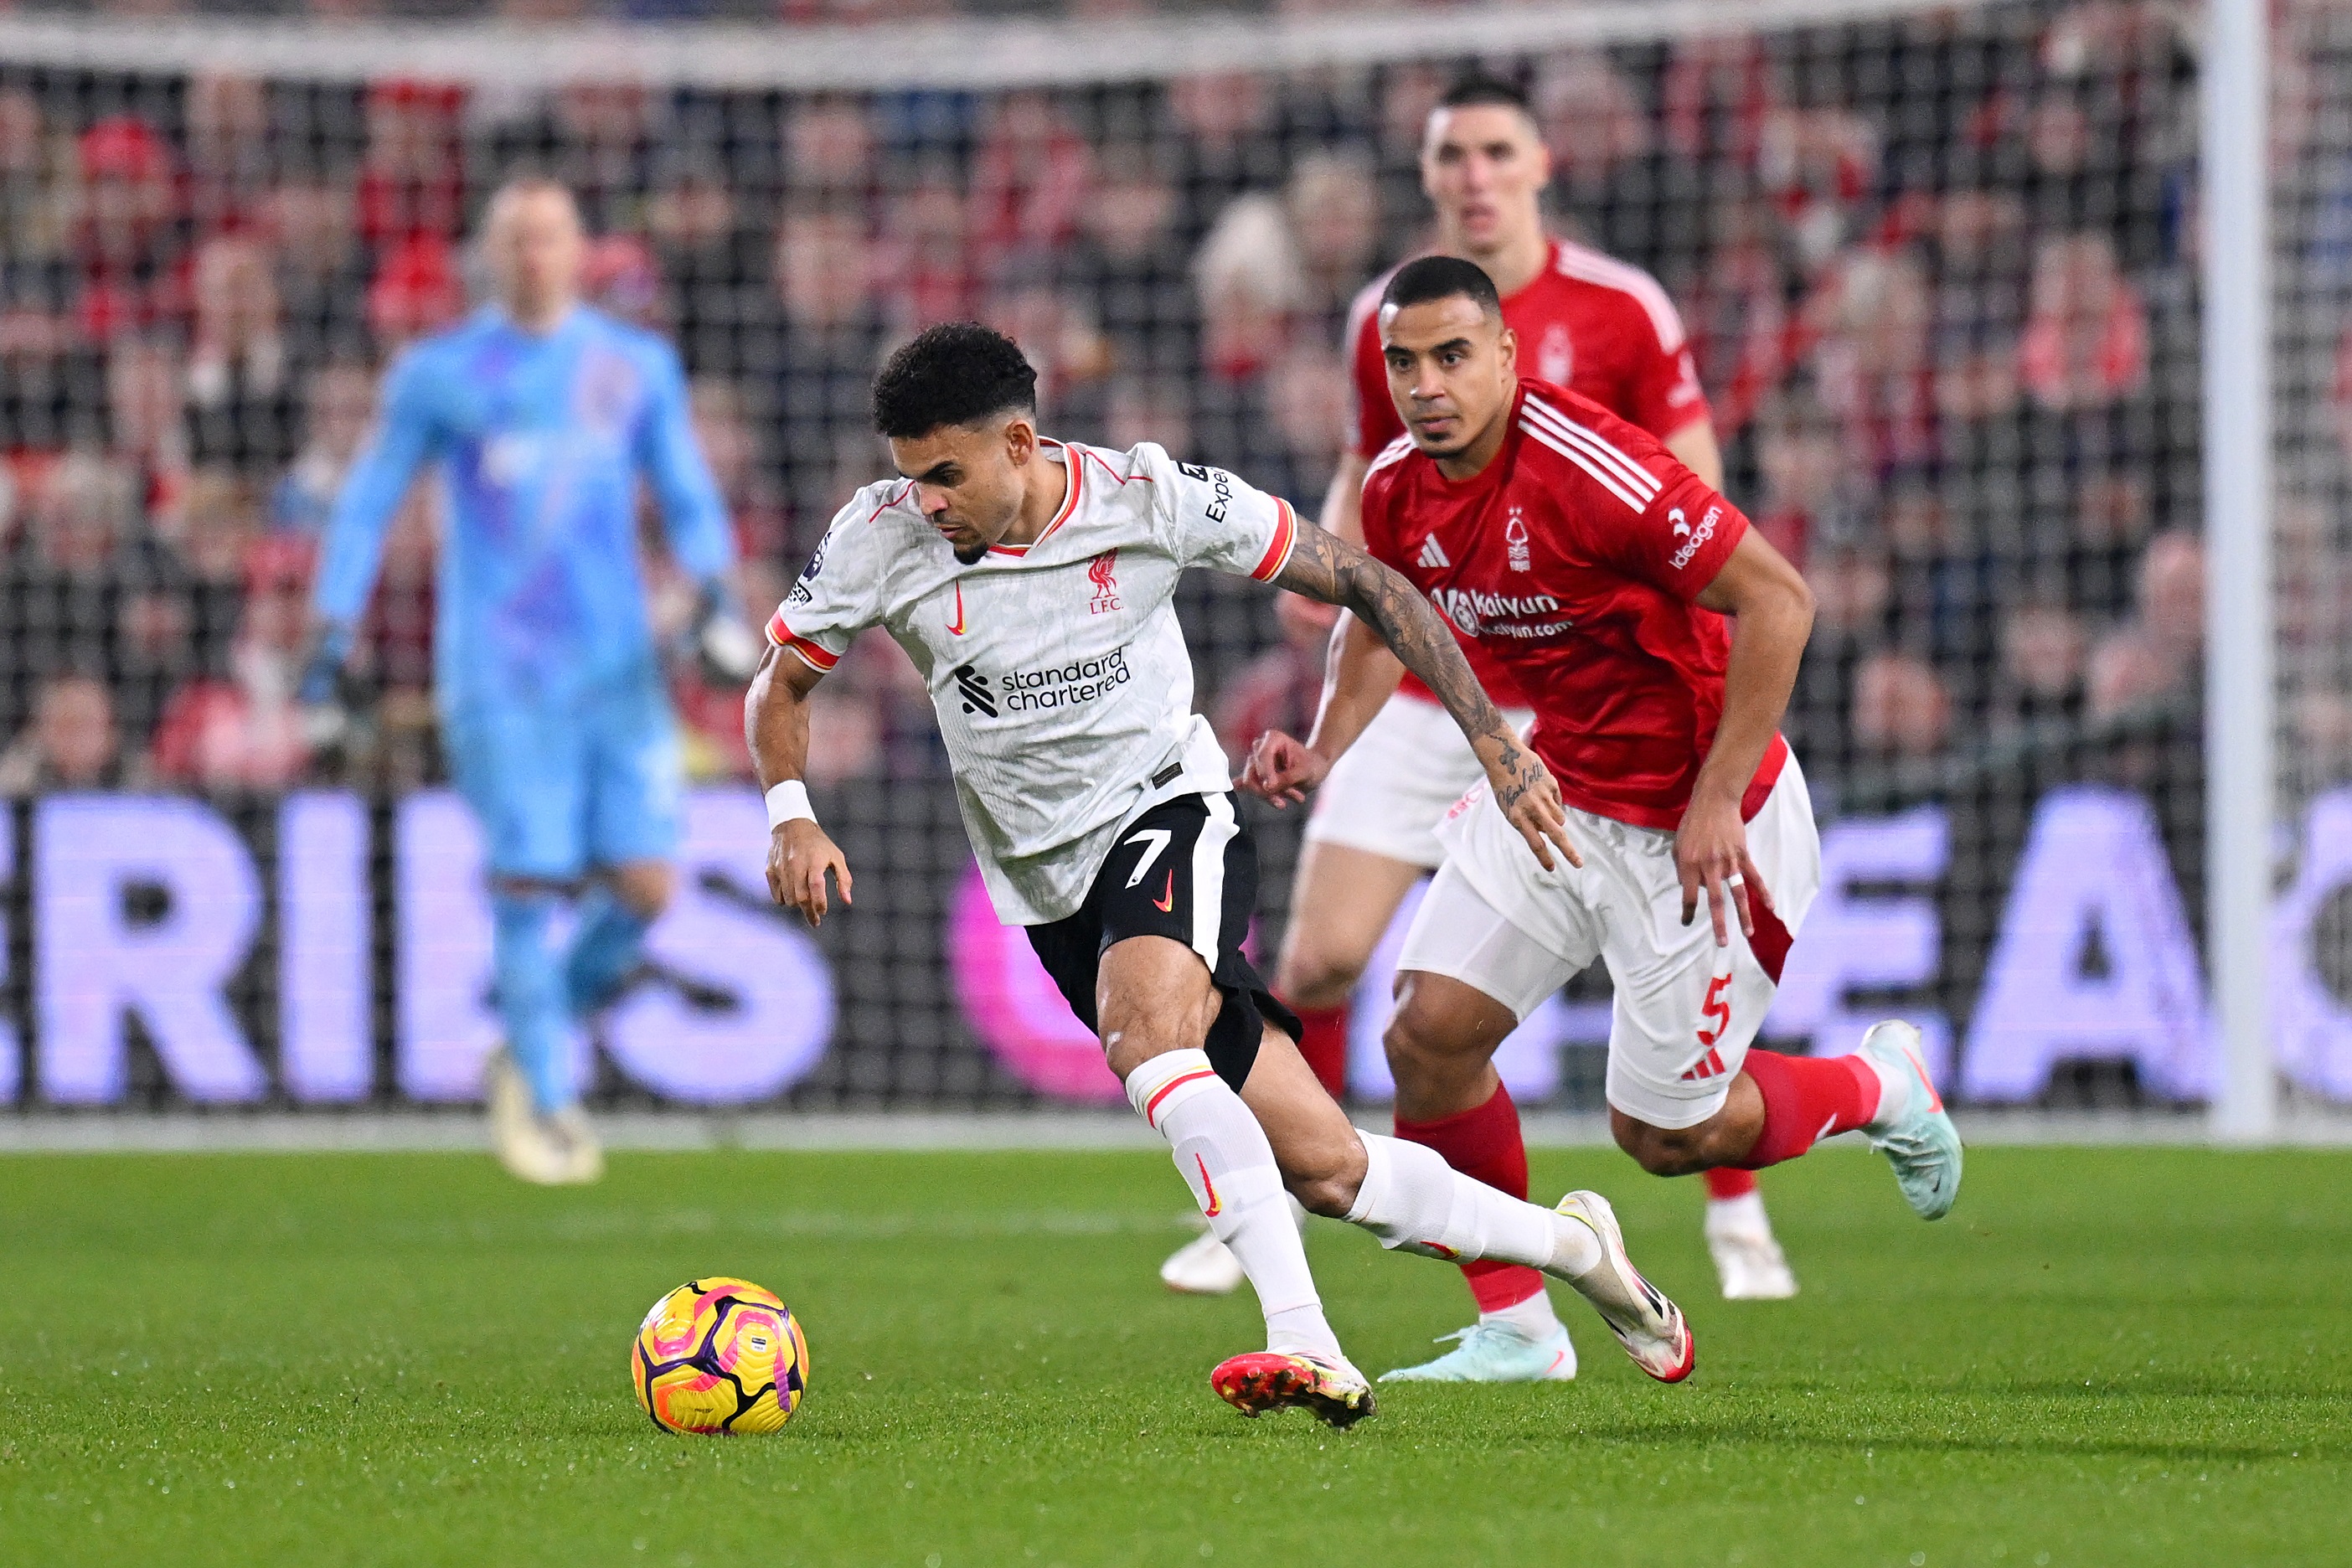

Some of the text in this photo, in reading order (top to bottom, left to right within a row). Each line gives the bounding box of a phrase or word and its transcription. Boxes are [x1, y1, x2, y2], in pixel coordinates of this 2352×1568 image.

[1668, 506, 1723, 570] Ideagen
[1002, 647, 1122, 691] standard
[1007, 661, 1131, 710] chartered
[1123, 828, 1172, 890] 7
[1696, 972, 1732, 1046] 5
